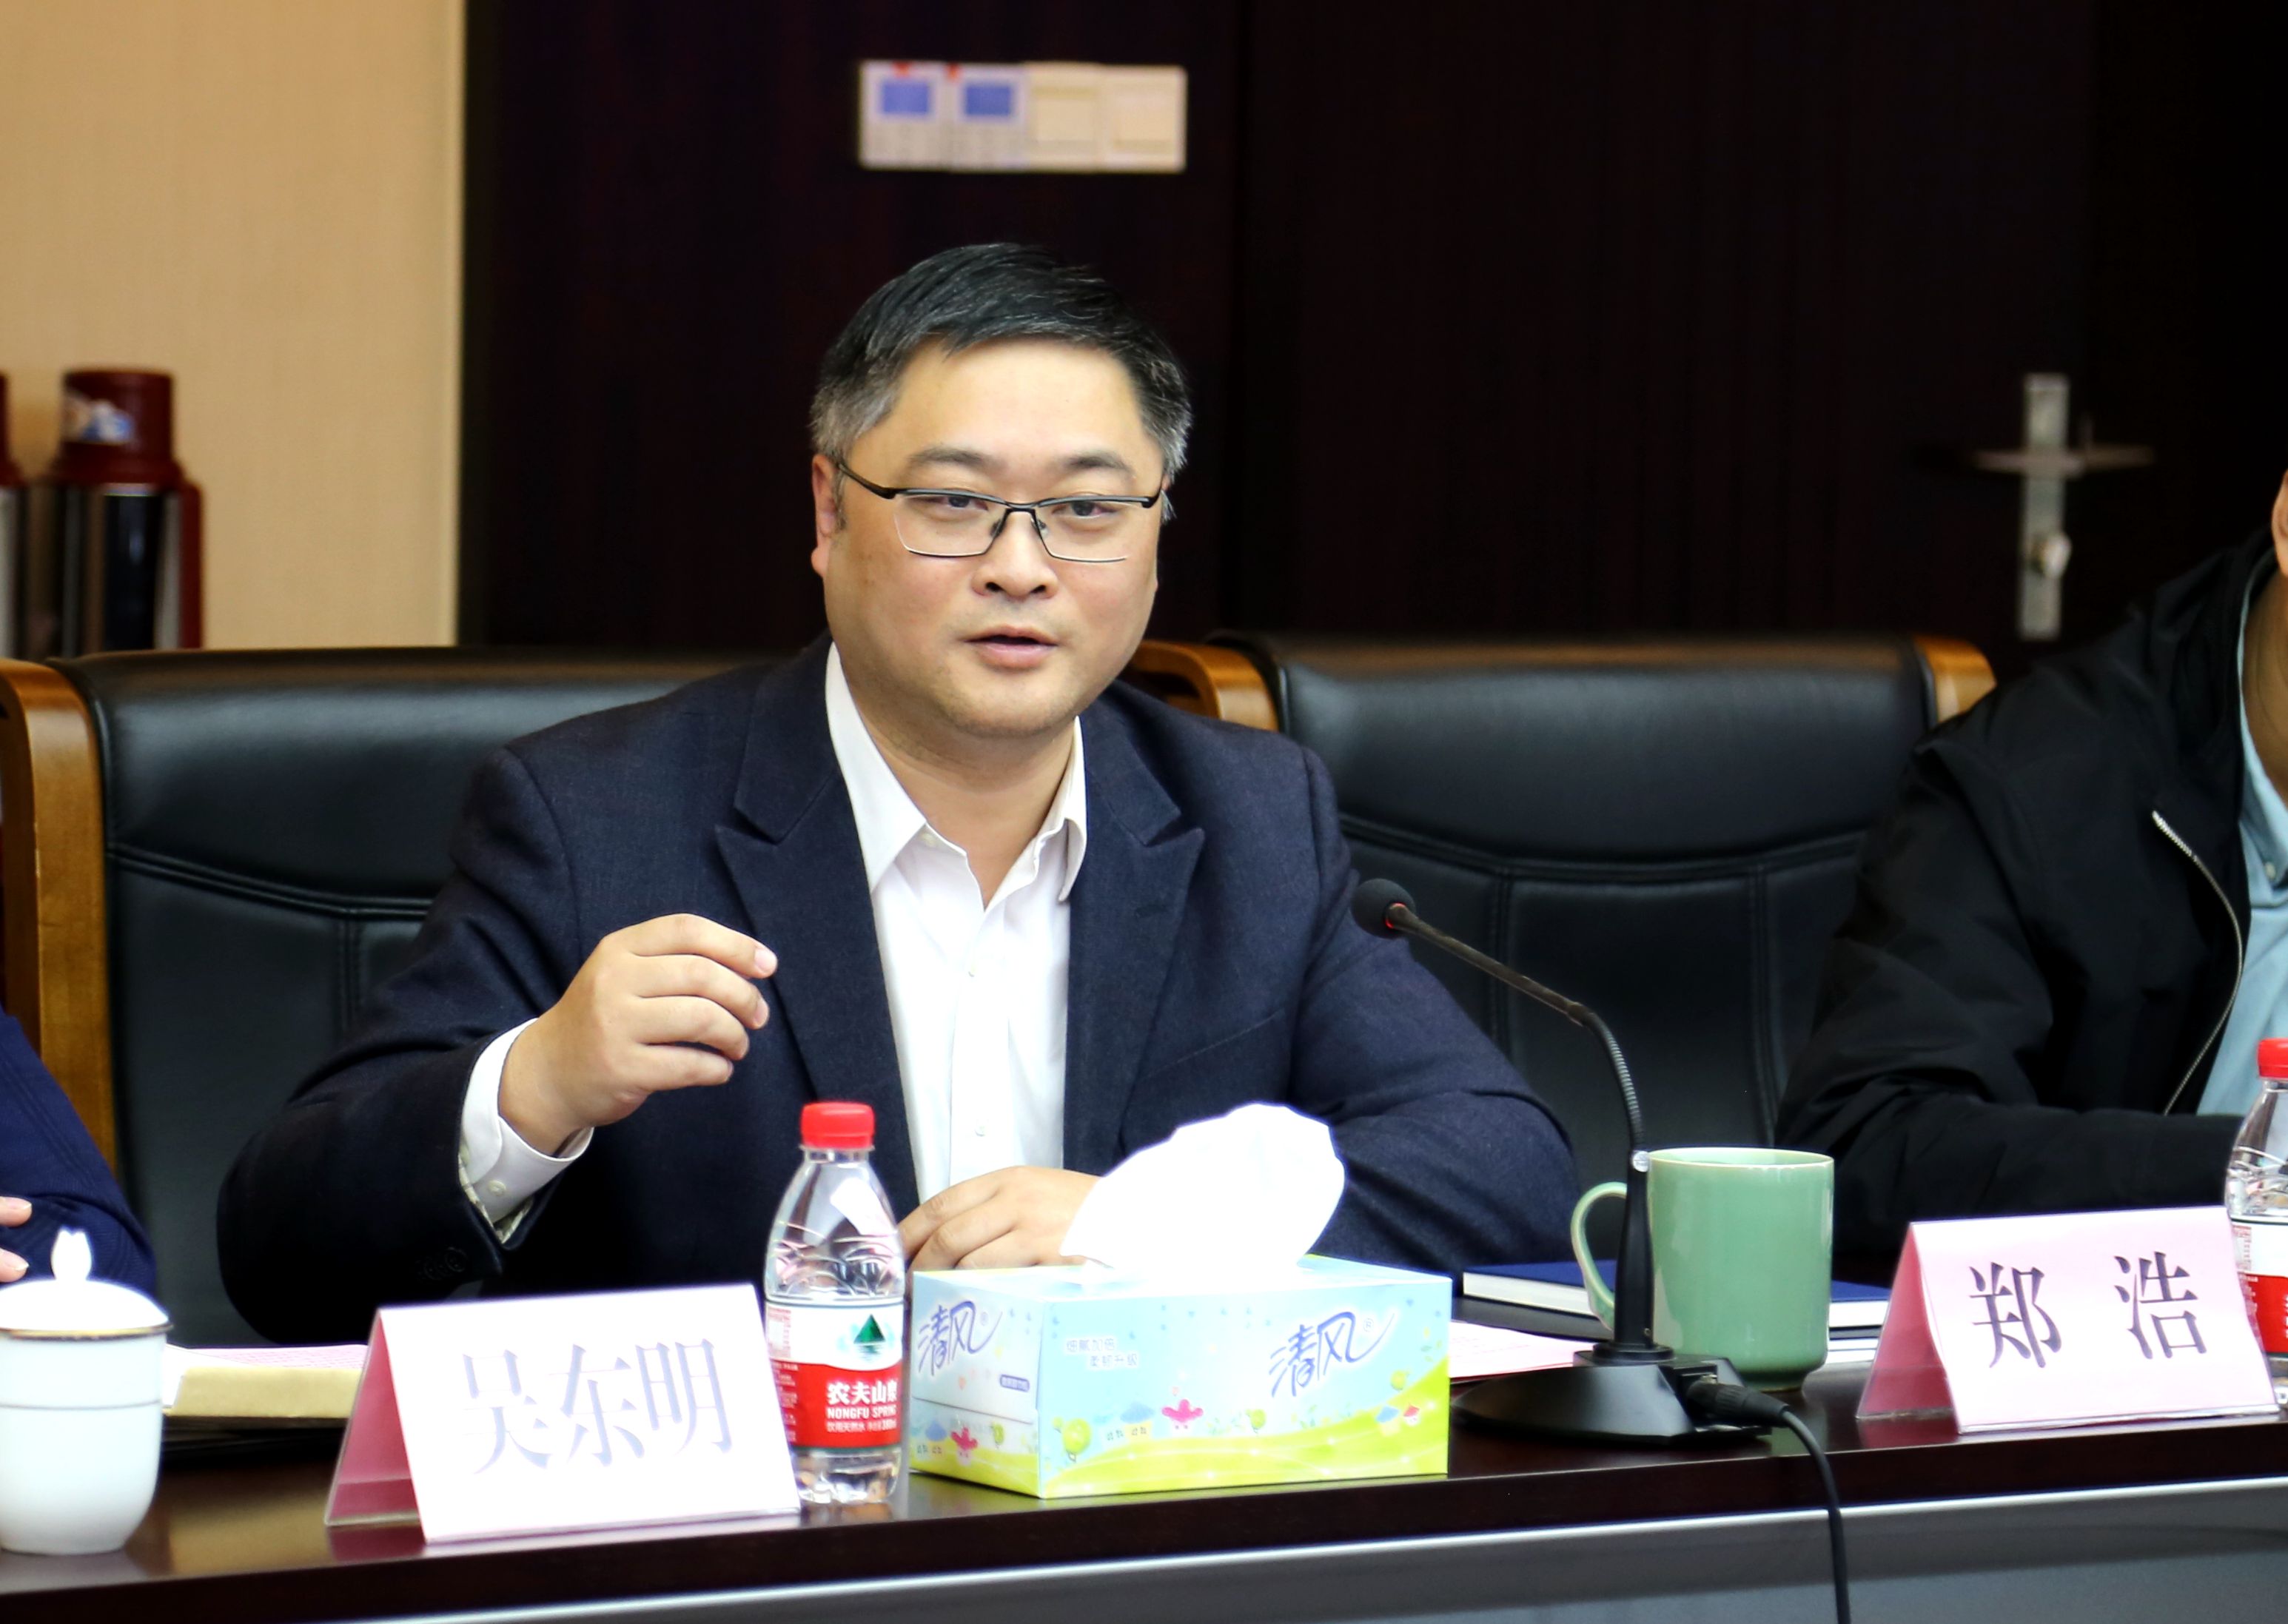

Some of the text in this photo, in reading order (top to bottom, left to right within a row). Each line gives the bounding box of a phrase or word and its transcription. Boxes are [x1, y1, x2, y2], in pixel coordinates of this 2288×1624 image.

[917, 1301, 1003, 1376] 清风
[1969, 1251, 2207, 1369] 郑浩
[828, 1380, 898, 1405] 农夫山泉
[1268, 1311, 1395, 1397] 清风
[462, 1338, 733, 1474] 吴东明
[827, 1407, 870, 1420] NONGFU
